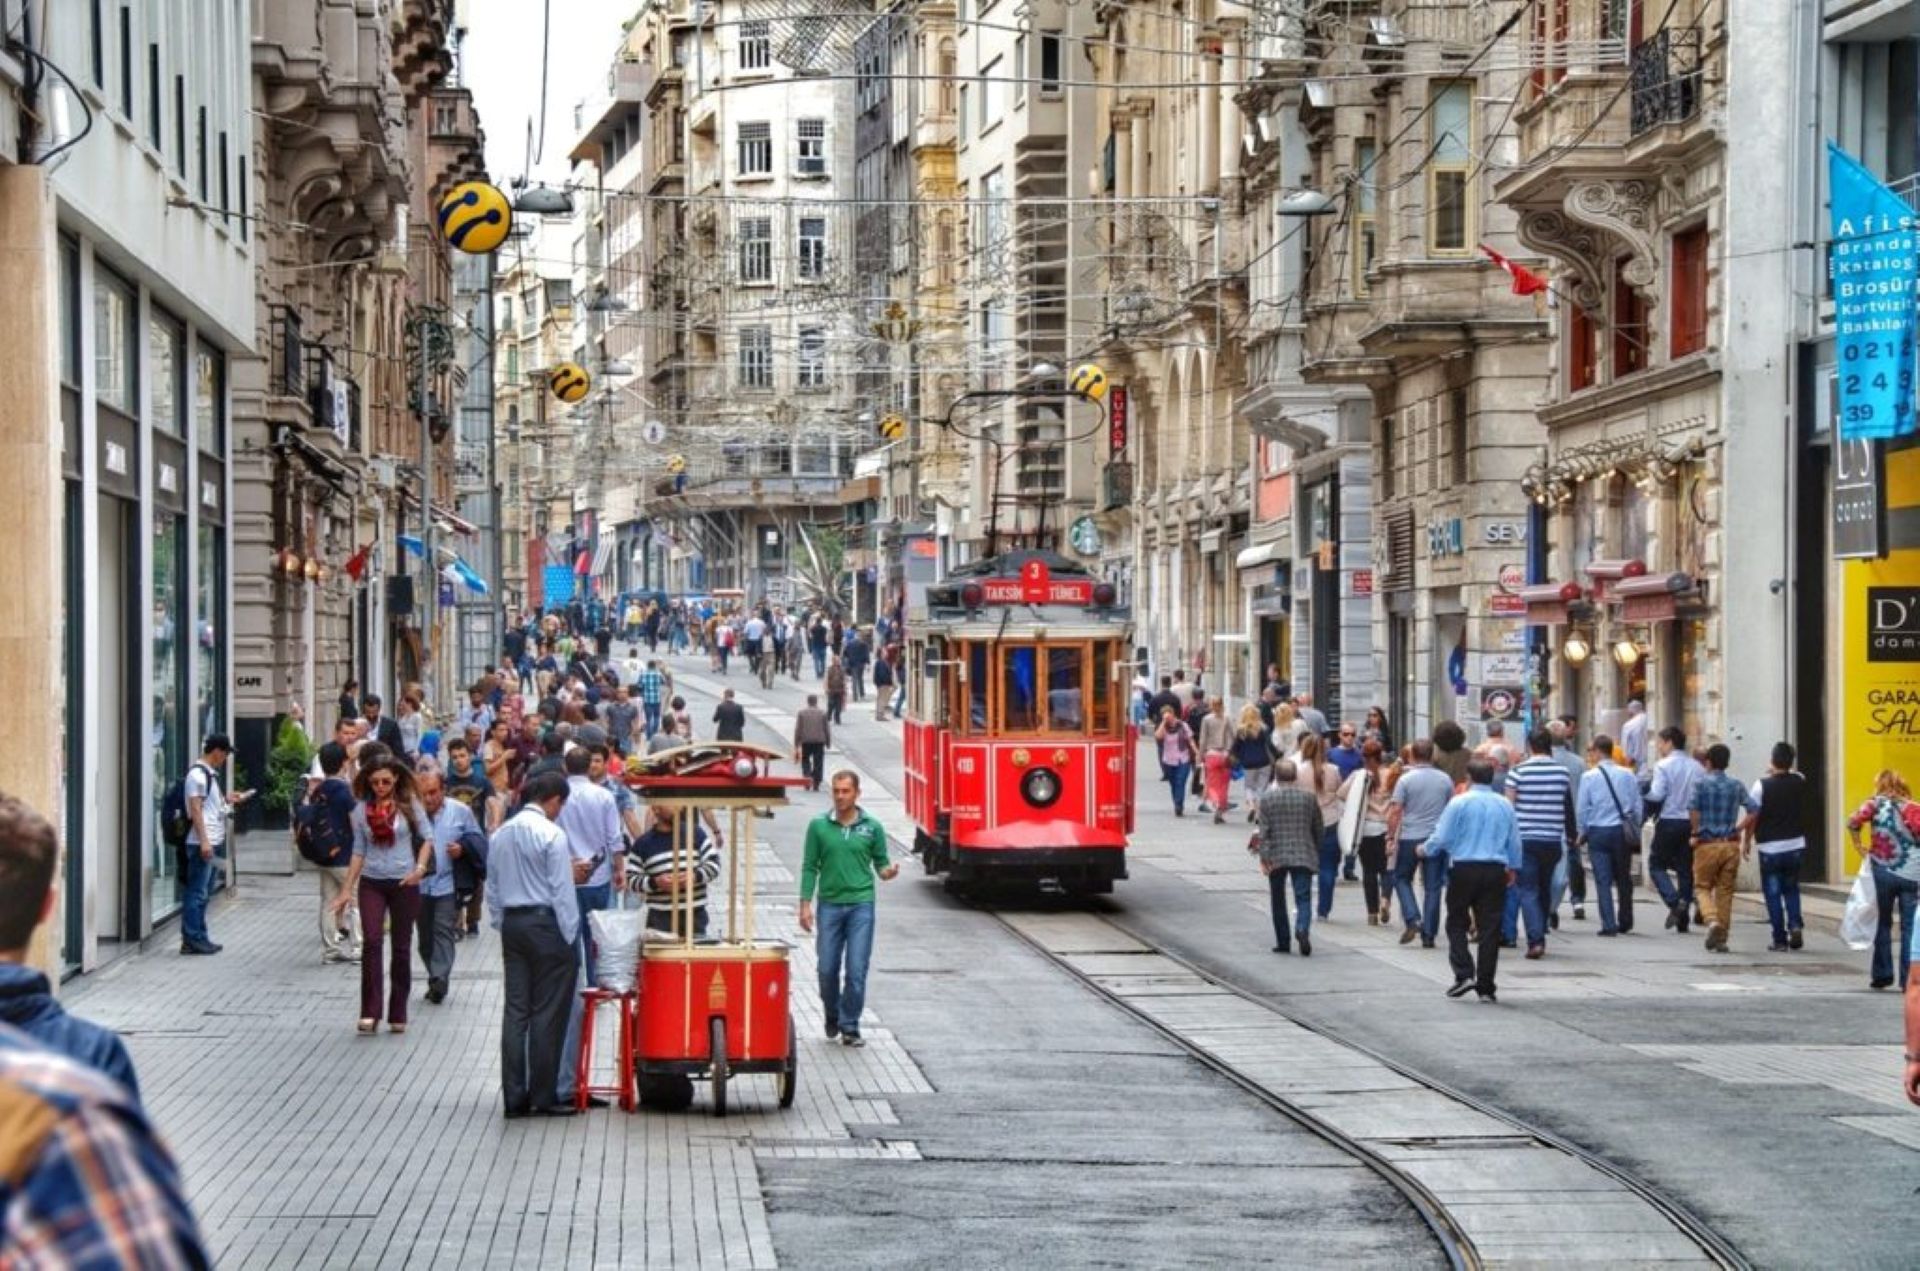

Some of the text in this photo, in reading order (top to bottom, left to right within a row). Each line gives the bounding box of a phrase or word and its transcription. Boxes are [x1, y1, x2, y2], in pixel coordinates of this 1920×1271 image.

[1838, 239, 1912, 256] Branda
[1839, 257, 1912, 273] Katalog
[1841, 276, 1911, 297] Broşür
[1842, 299, 1911, 315] Kartvizit
[1844, 340, 1912, 361] 0212
[1845, 404, 1874, 421] 39
[1030, 562, 1040, 579] 3
[1049, 584, 1086, 601] TÜNEL
[237, 677, 262, 687] CAFE
